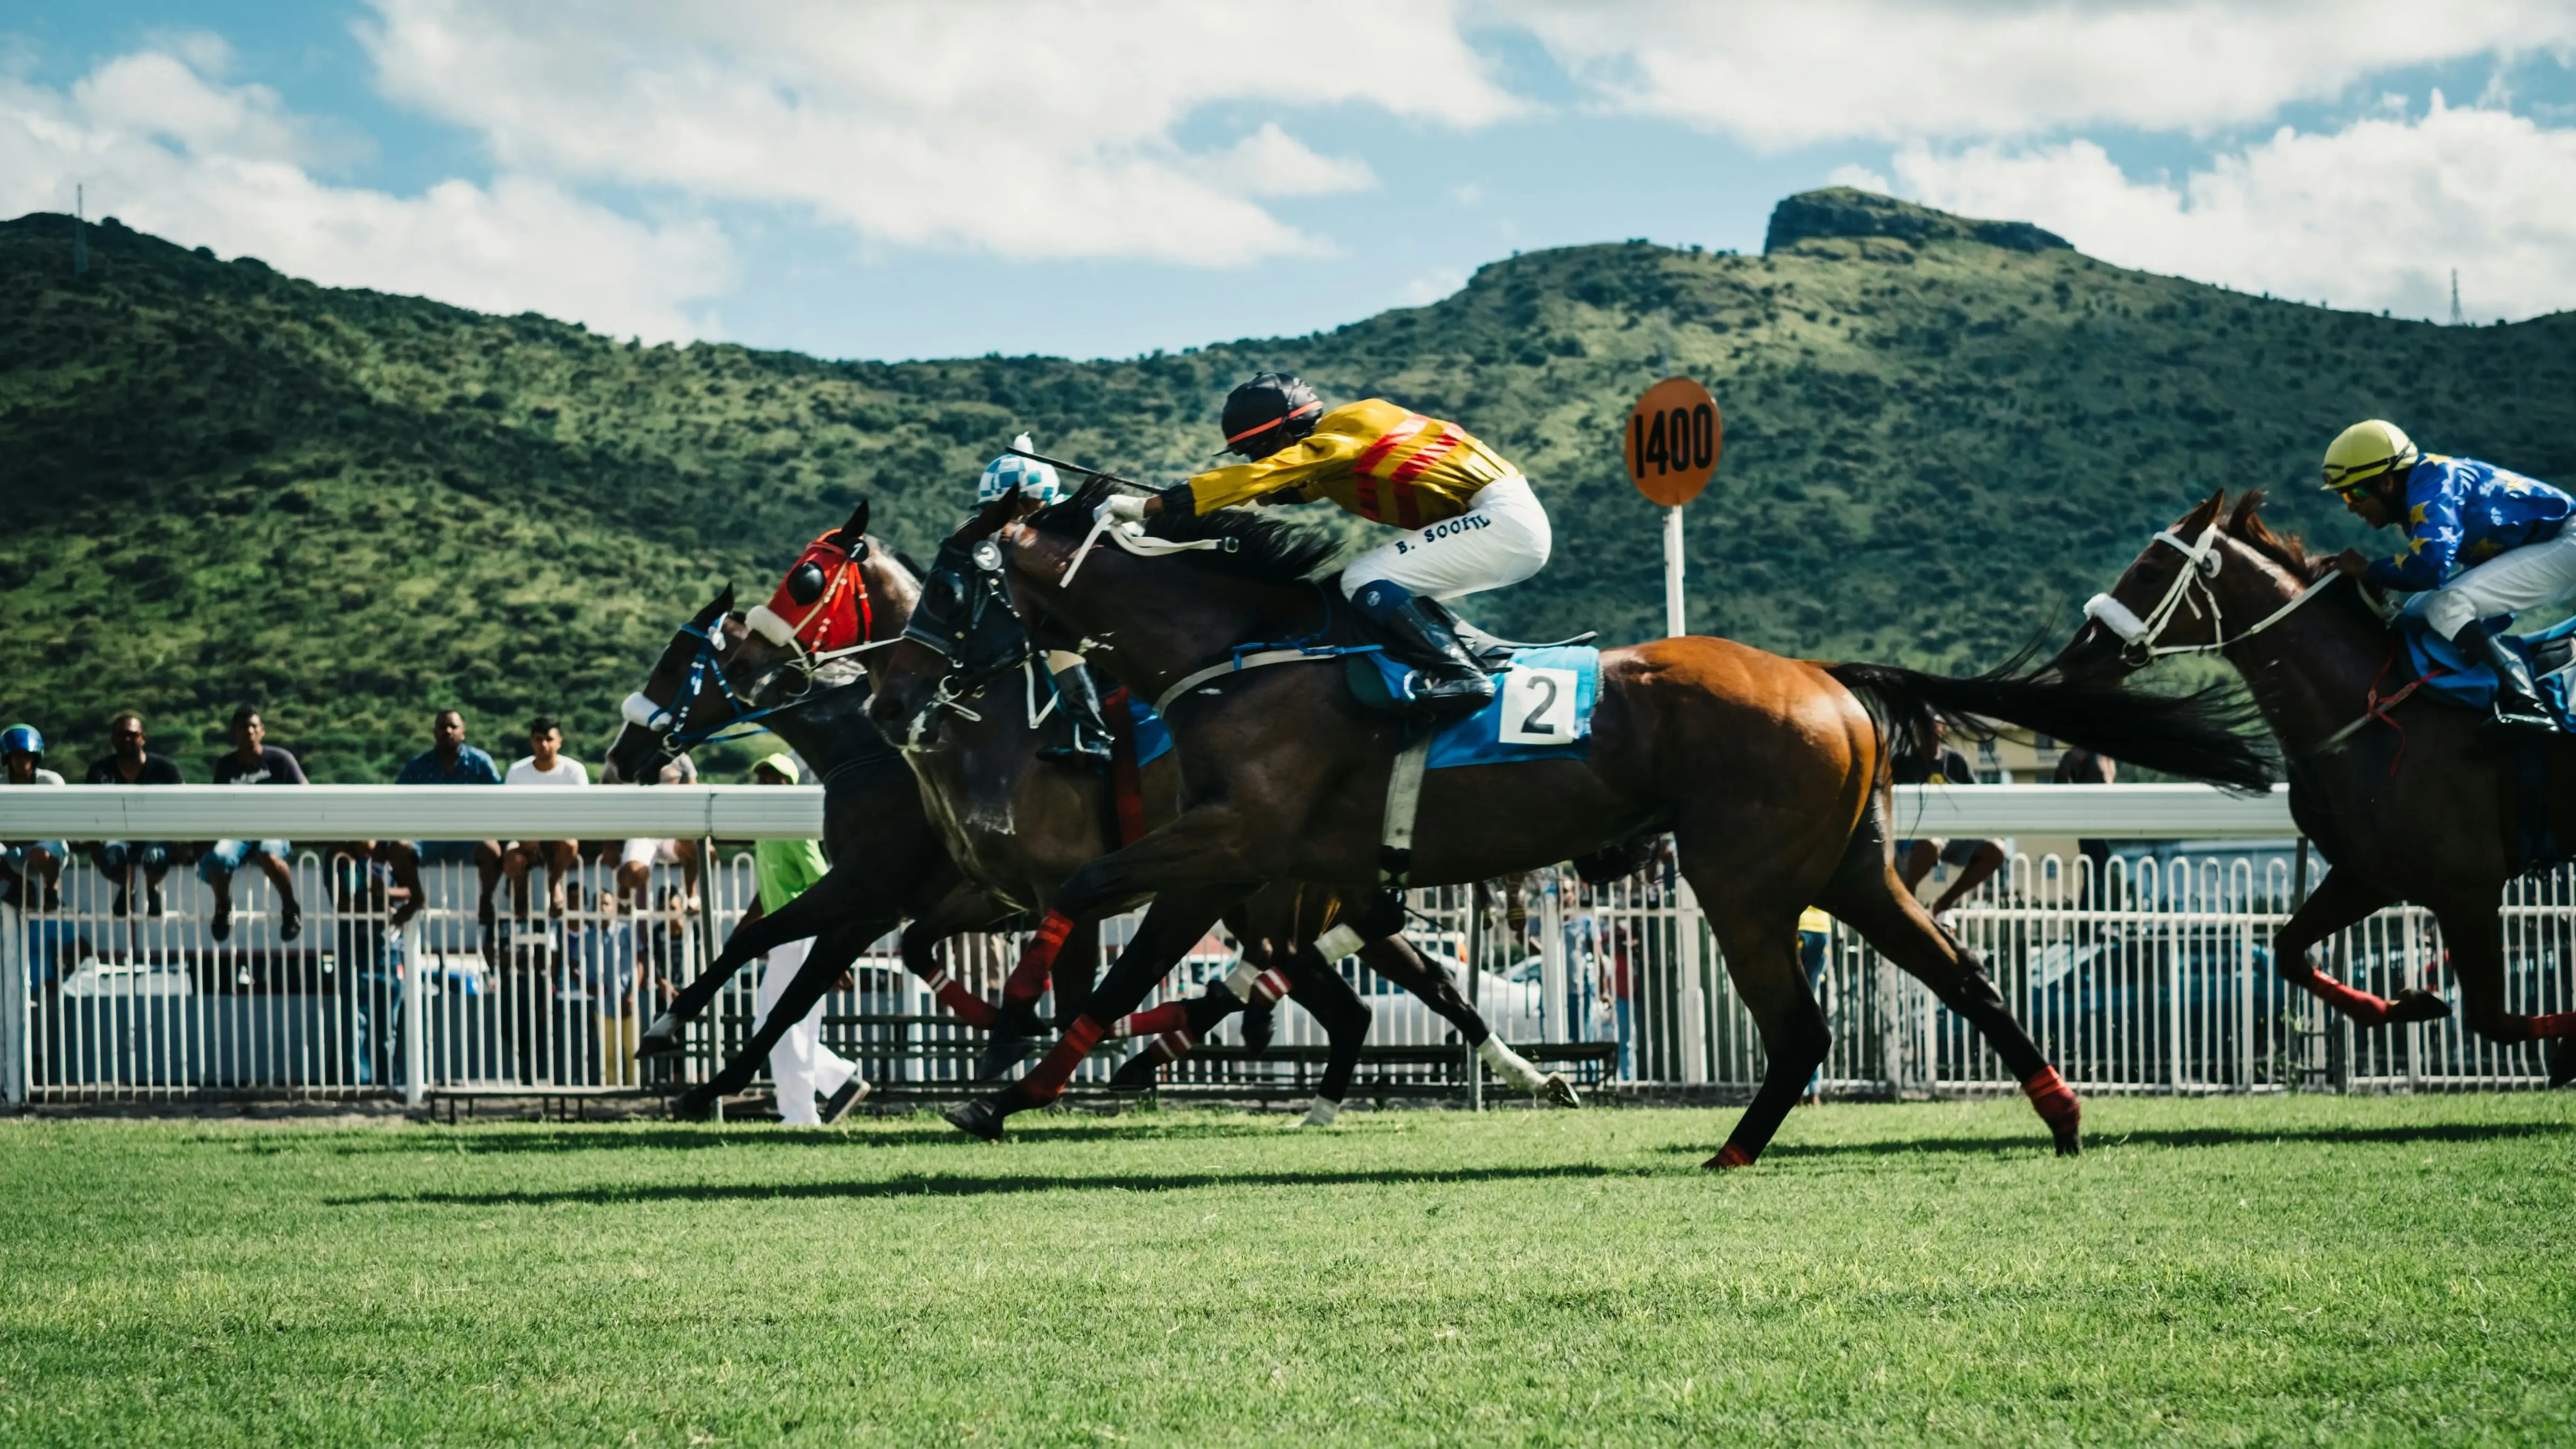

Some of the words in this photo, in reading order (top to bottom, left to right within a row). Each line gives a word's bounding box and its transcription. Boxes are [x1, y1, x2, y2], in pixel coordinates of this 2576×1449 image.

[1635, 403, 1713, 479] 1400
[850, 542, 864, 558] 1
[976, 546, 996, 566] 2
[1395, 541, 1416, 555] B.
[1521, 675, 1557, 735] 2
